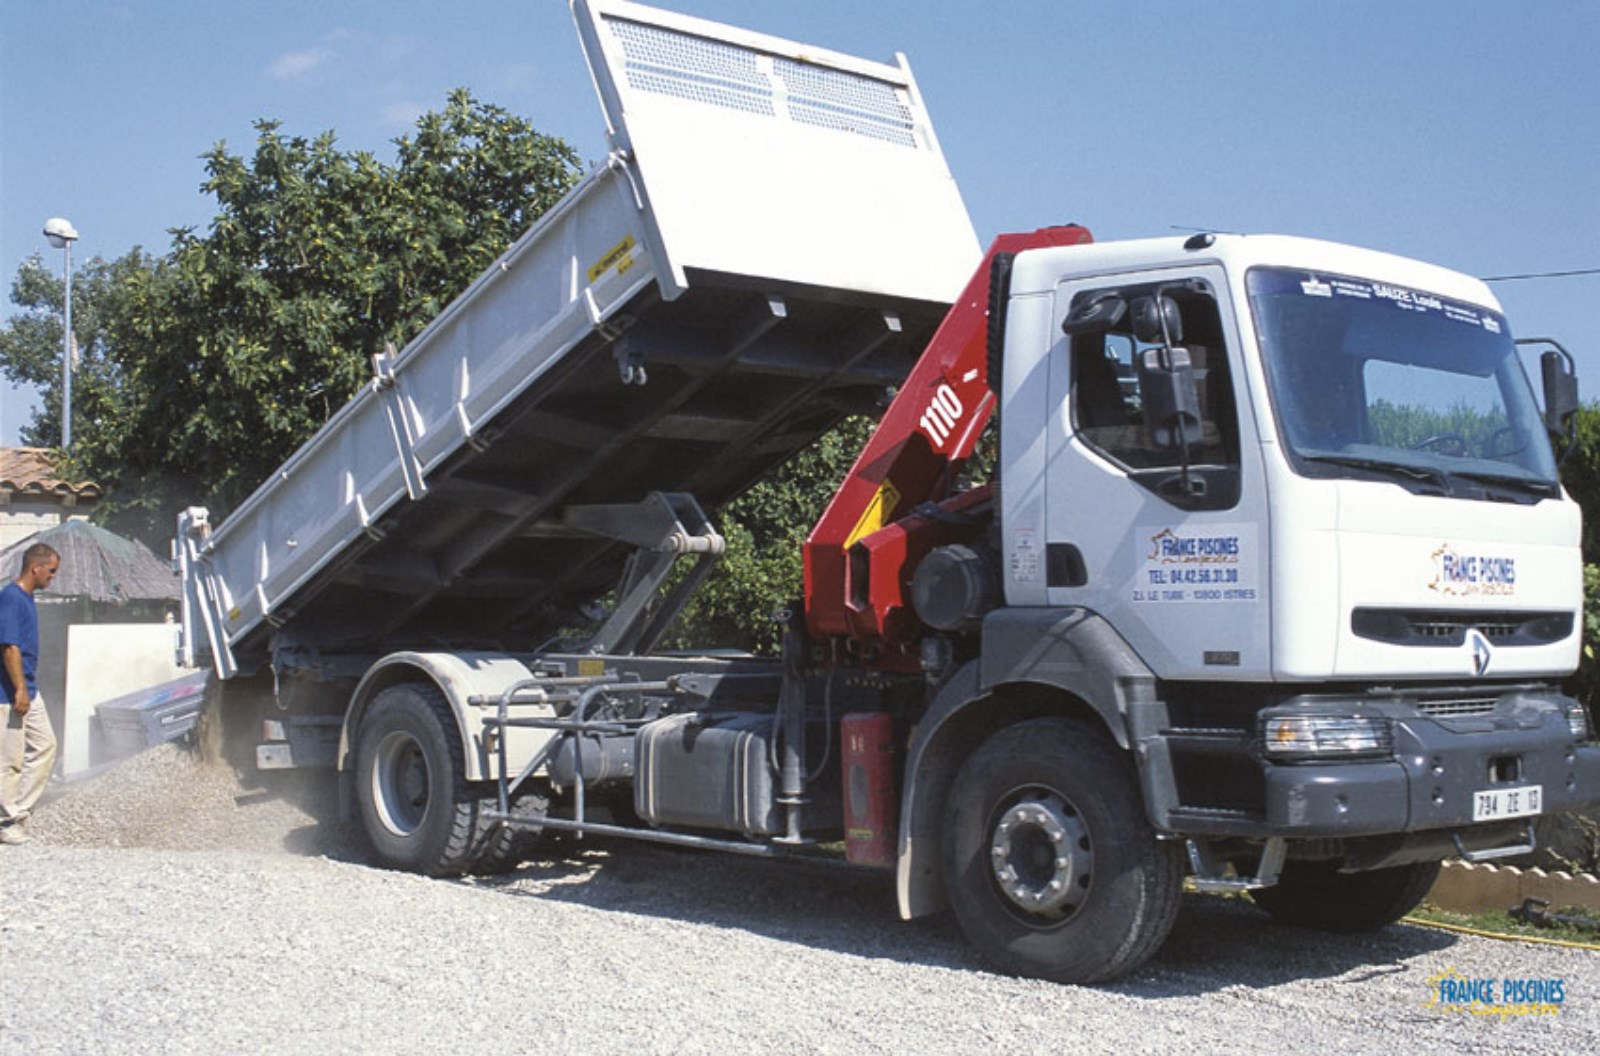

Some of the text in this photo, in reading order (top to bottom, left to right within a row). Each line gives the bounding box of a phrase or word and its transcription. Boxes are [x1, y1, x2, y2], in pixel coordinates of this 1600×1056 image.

[920, 384, 963, 447] 1110
[1162, 537, 1239, 555] FRANCE PISCINES
[1443, 555, 1476, 582] FRANCE
